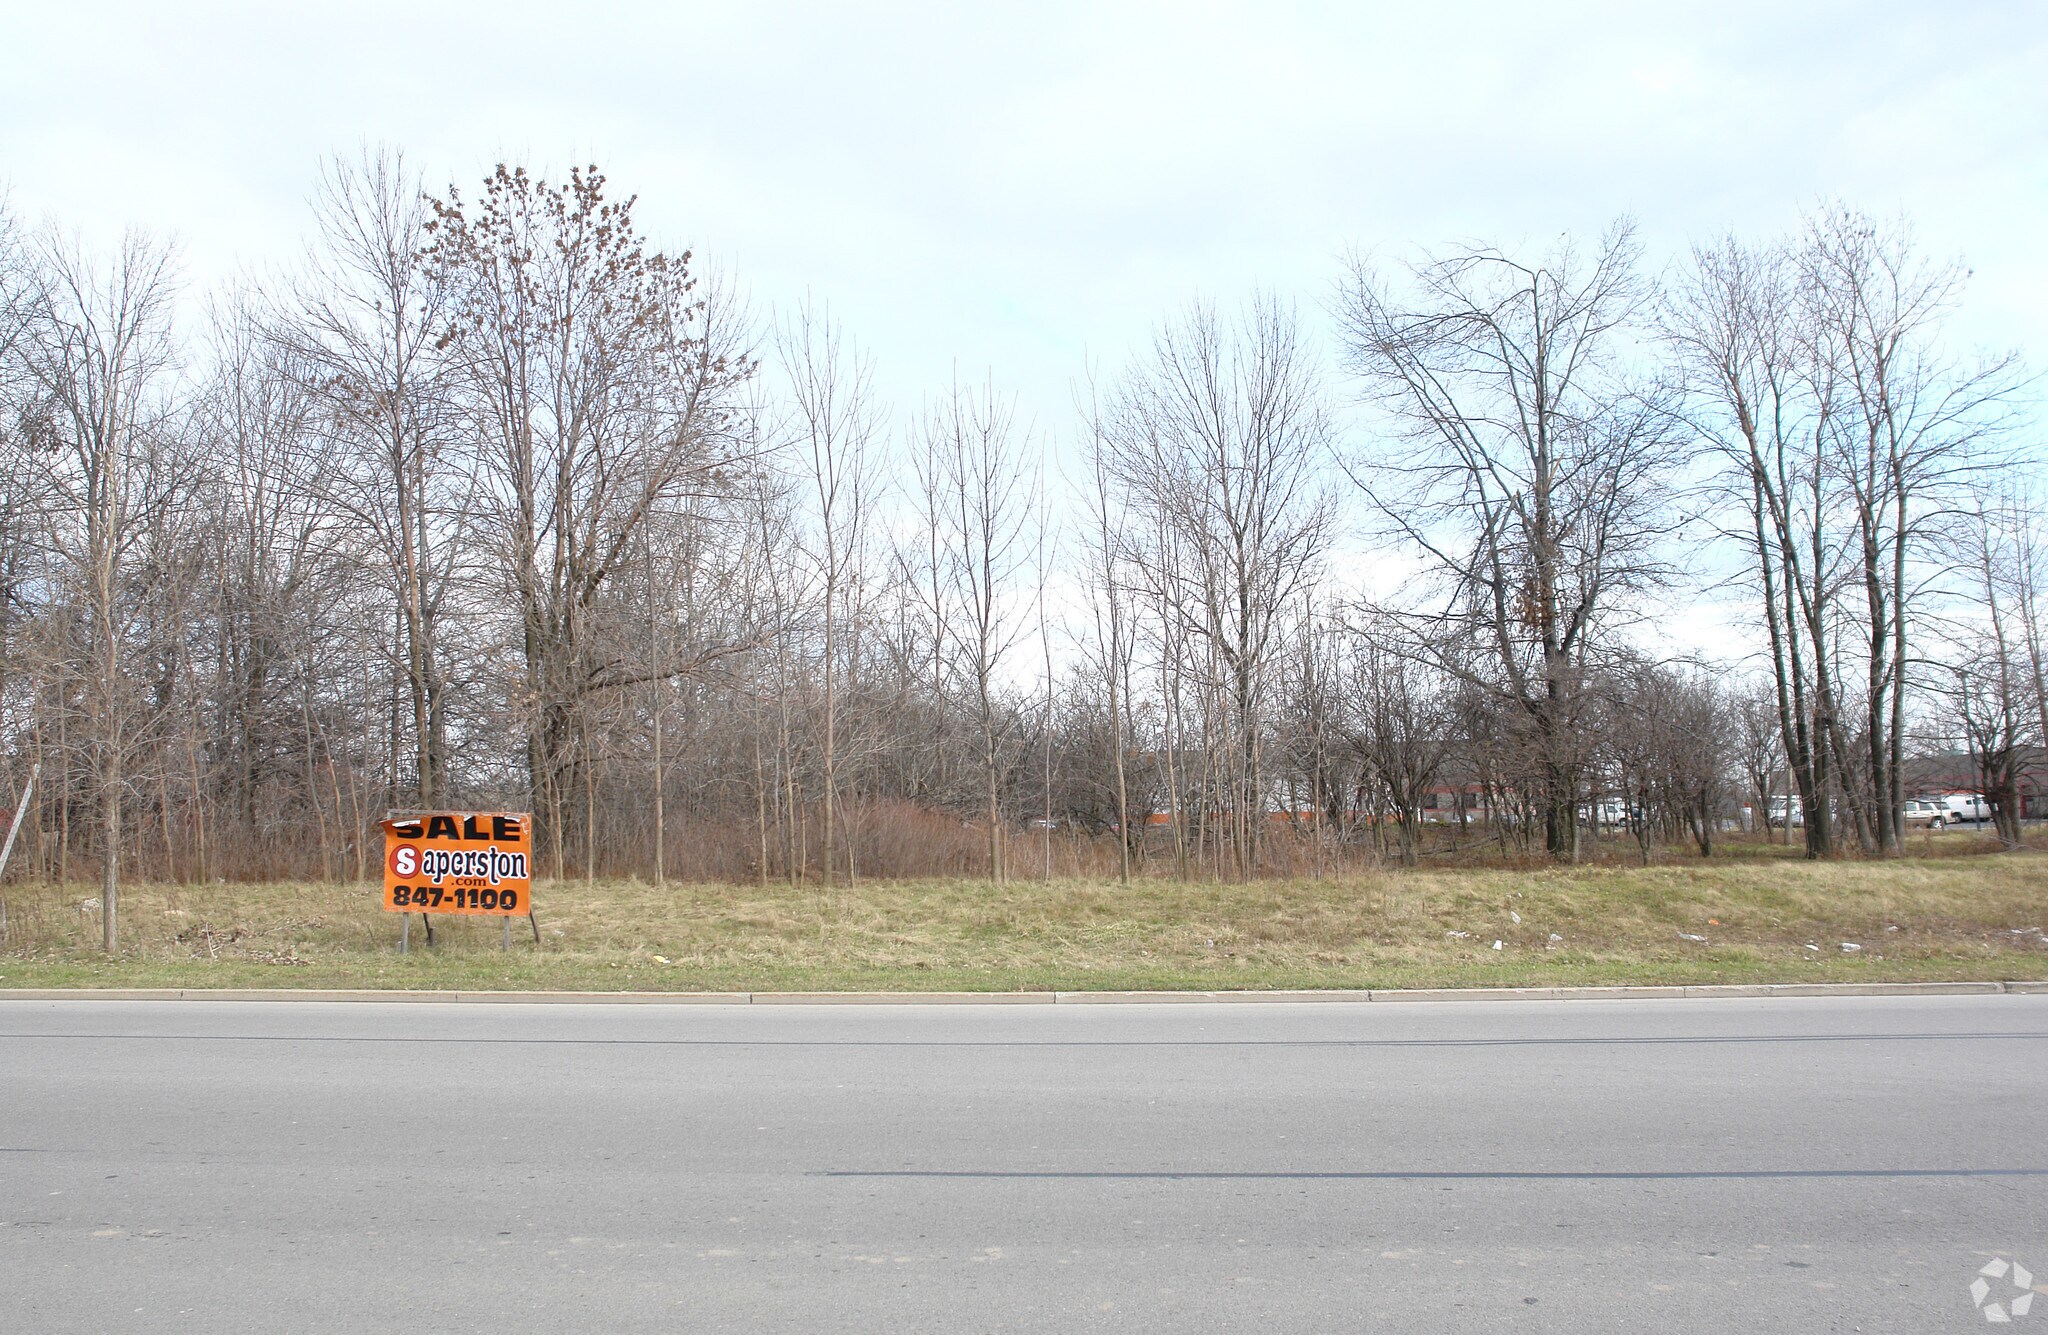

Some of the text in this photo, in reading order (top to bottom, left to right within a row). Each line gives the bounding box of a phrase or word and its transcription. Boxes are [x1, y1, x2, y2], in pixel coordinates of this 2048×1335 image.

[396, 816, 520, 841] SALE
[395, 846, 528, 885] Saperston
[393, 885, 517, 910] 847-1100
